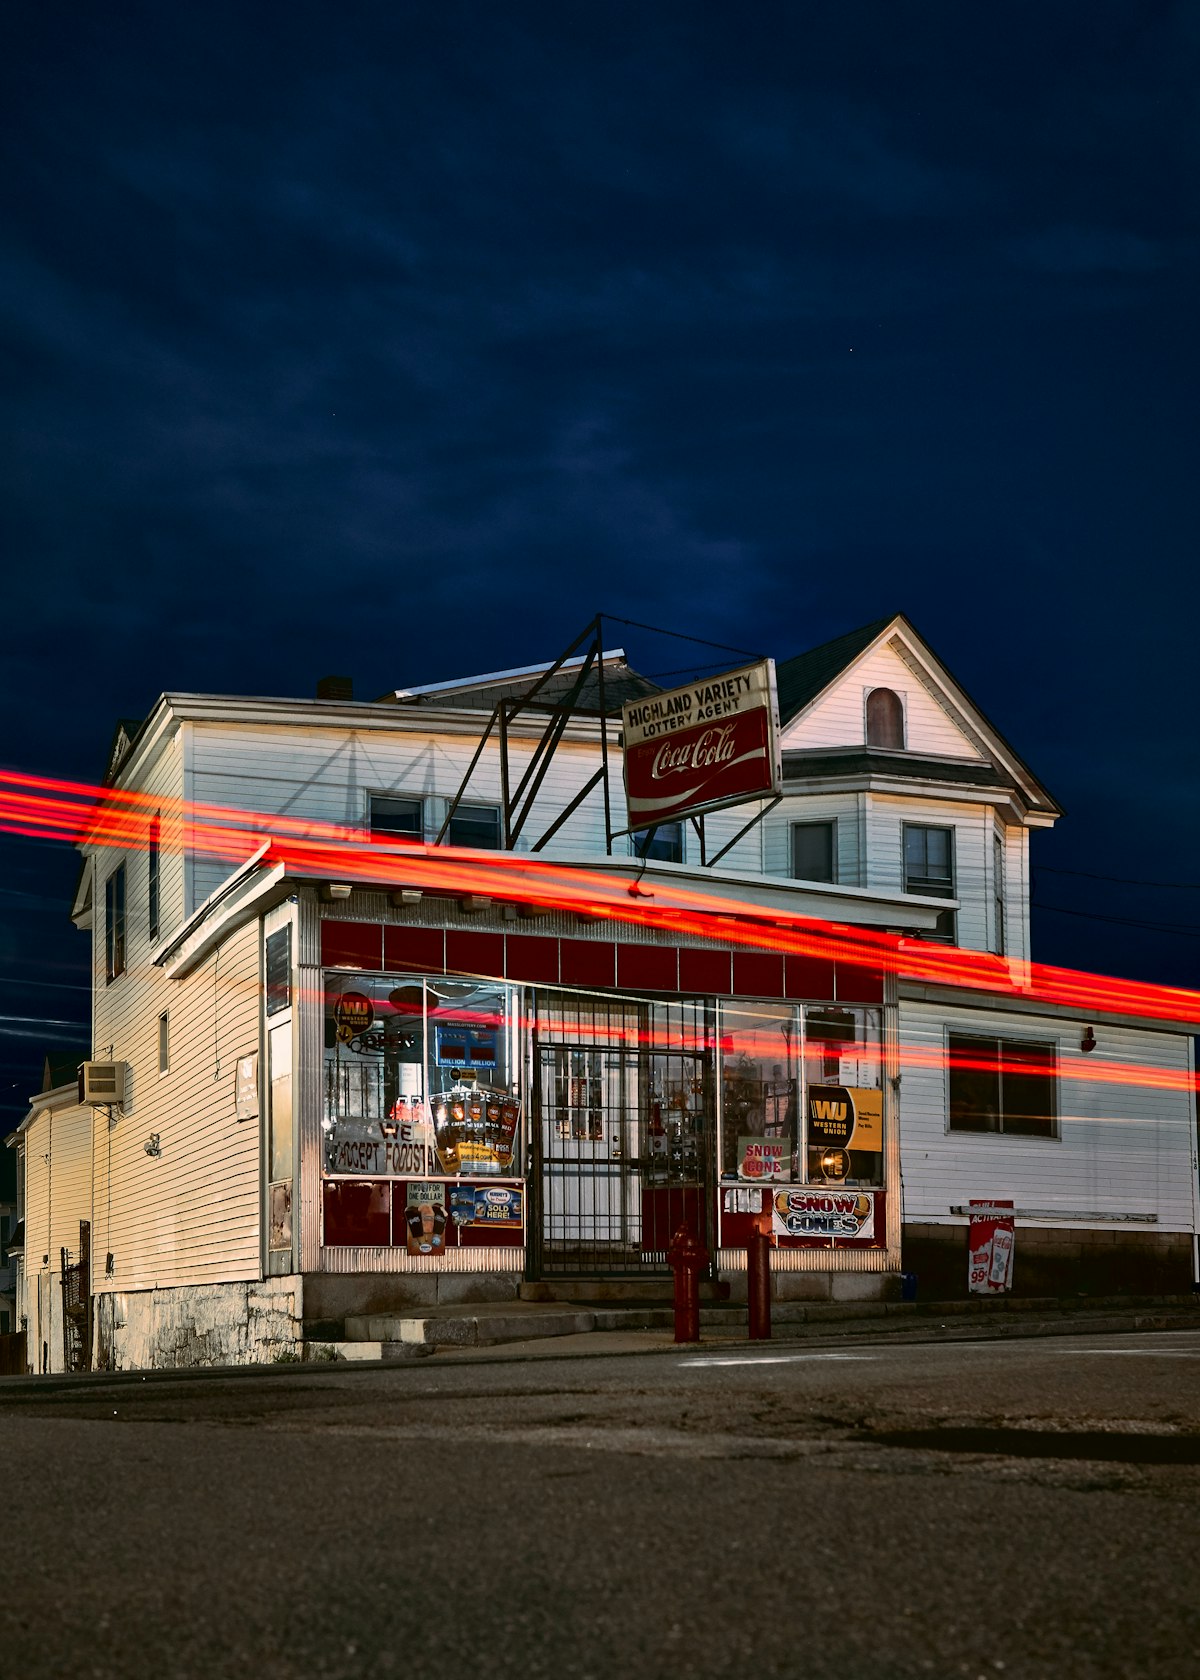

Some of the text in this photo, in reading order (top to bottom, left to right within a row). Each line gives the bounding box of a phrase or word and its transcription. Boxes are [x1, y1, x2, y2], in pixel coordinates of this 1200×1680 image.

[628, 672, 751, 728] HIGHLAND VARIETY
[643, 698, 740, 738] LOTTERY AGENT
[651, 722, 738, 780] Coca-Cola
[342, 1001, 369, 1015] WU
[470, 1059, 496, 1067] MILLION
[811, 1100, 848, 1122] WU
[378, 1122, 412, 1141] WE
[813, 1121, 847, 1130] WESTERN
[823, 1128, 847, 1136] UNION
[338, 1141, 380, 1171] ACCEPT
[746, 1145, 783, 1156] SNOW
[747, 1161, 782, 1173] CONE
[428, 1184, 441, 1192] FOR
[409, 1192, 420, 1200] ONE
[487, 1204, 509, 1212] SOLD
[789, 1192, 857, 1214] SNOW
[487, 1211, 510, 1219] HERE!
[787, 1213, 859, 1234] CONES
